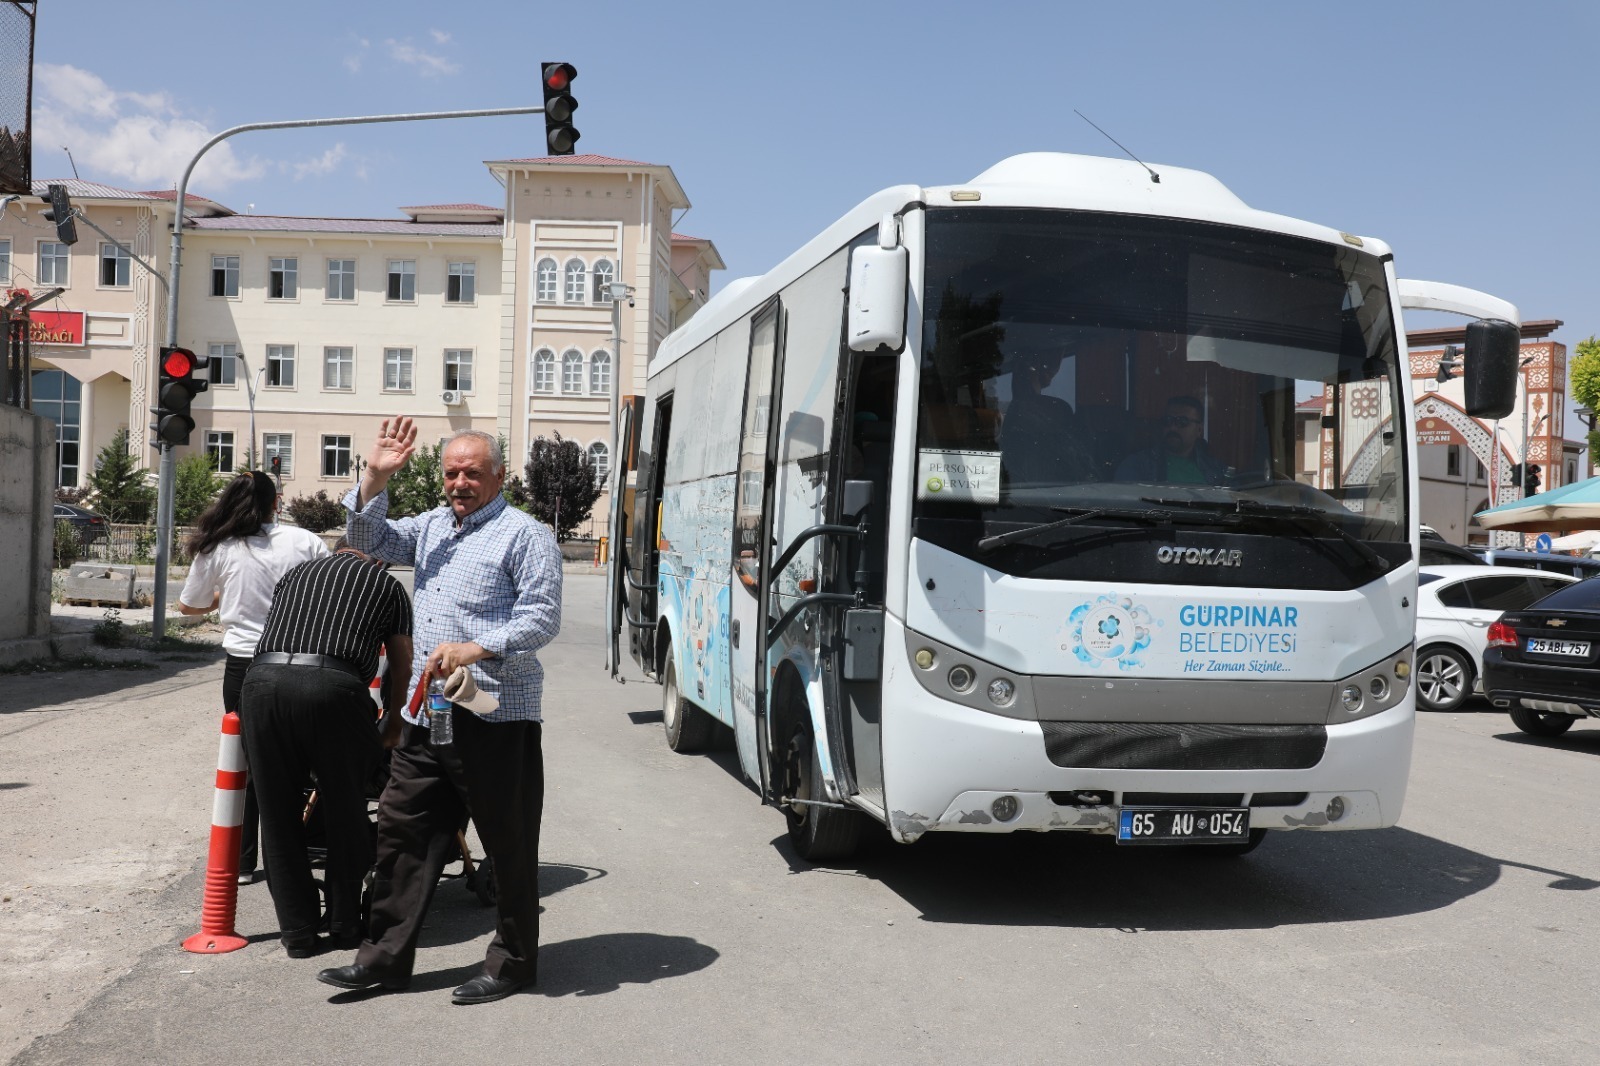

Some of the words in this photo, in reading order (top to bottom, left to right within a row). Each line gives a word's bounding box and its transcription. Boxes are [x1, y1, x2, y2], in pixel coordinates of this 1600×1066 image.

[929, 463, 988, 475] PERSONEL
[1157, 545, 1243, 567] OTOKAR
[1180, 605, 1298, 627] GÜRPINAR
[1532, 641, 1546, 652] 25
[1547, 642, 1567, 654] ABL
[1568, 643, 1589, 655] 757
[1183, 659, 1205, 673] Her
[1206, 660, 1246, 672] Zaman
[1132, 814, 1155, 835] 65
[1171, 814, 1194, 835] AU
[1210, 814, 1243, 835] 054
